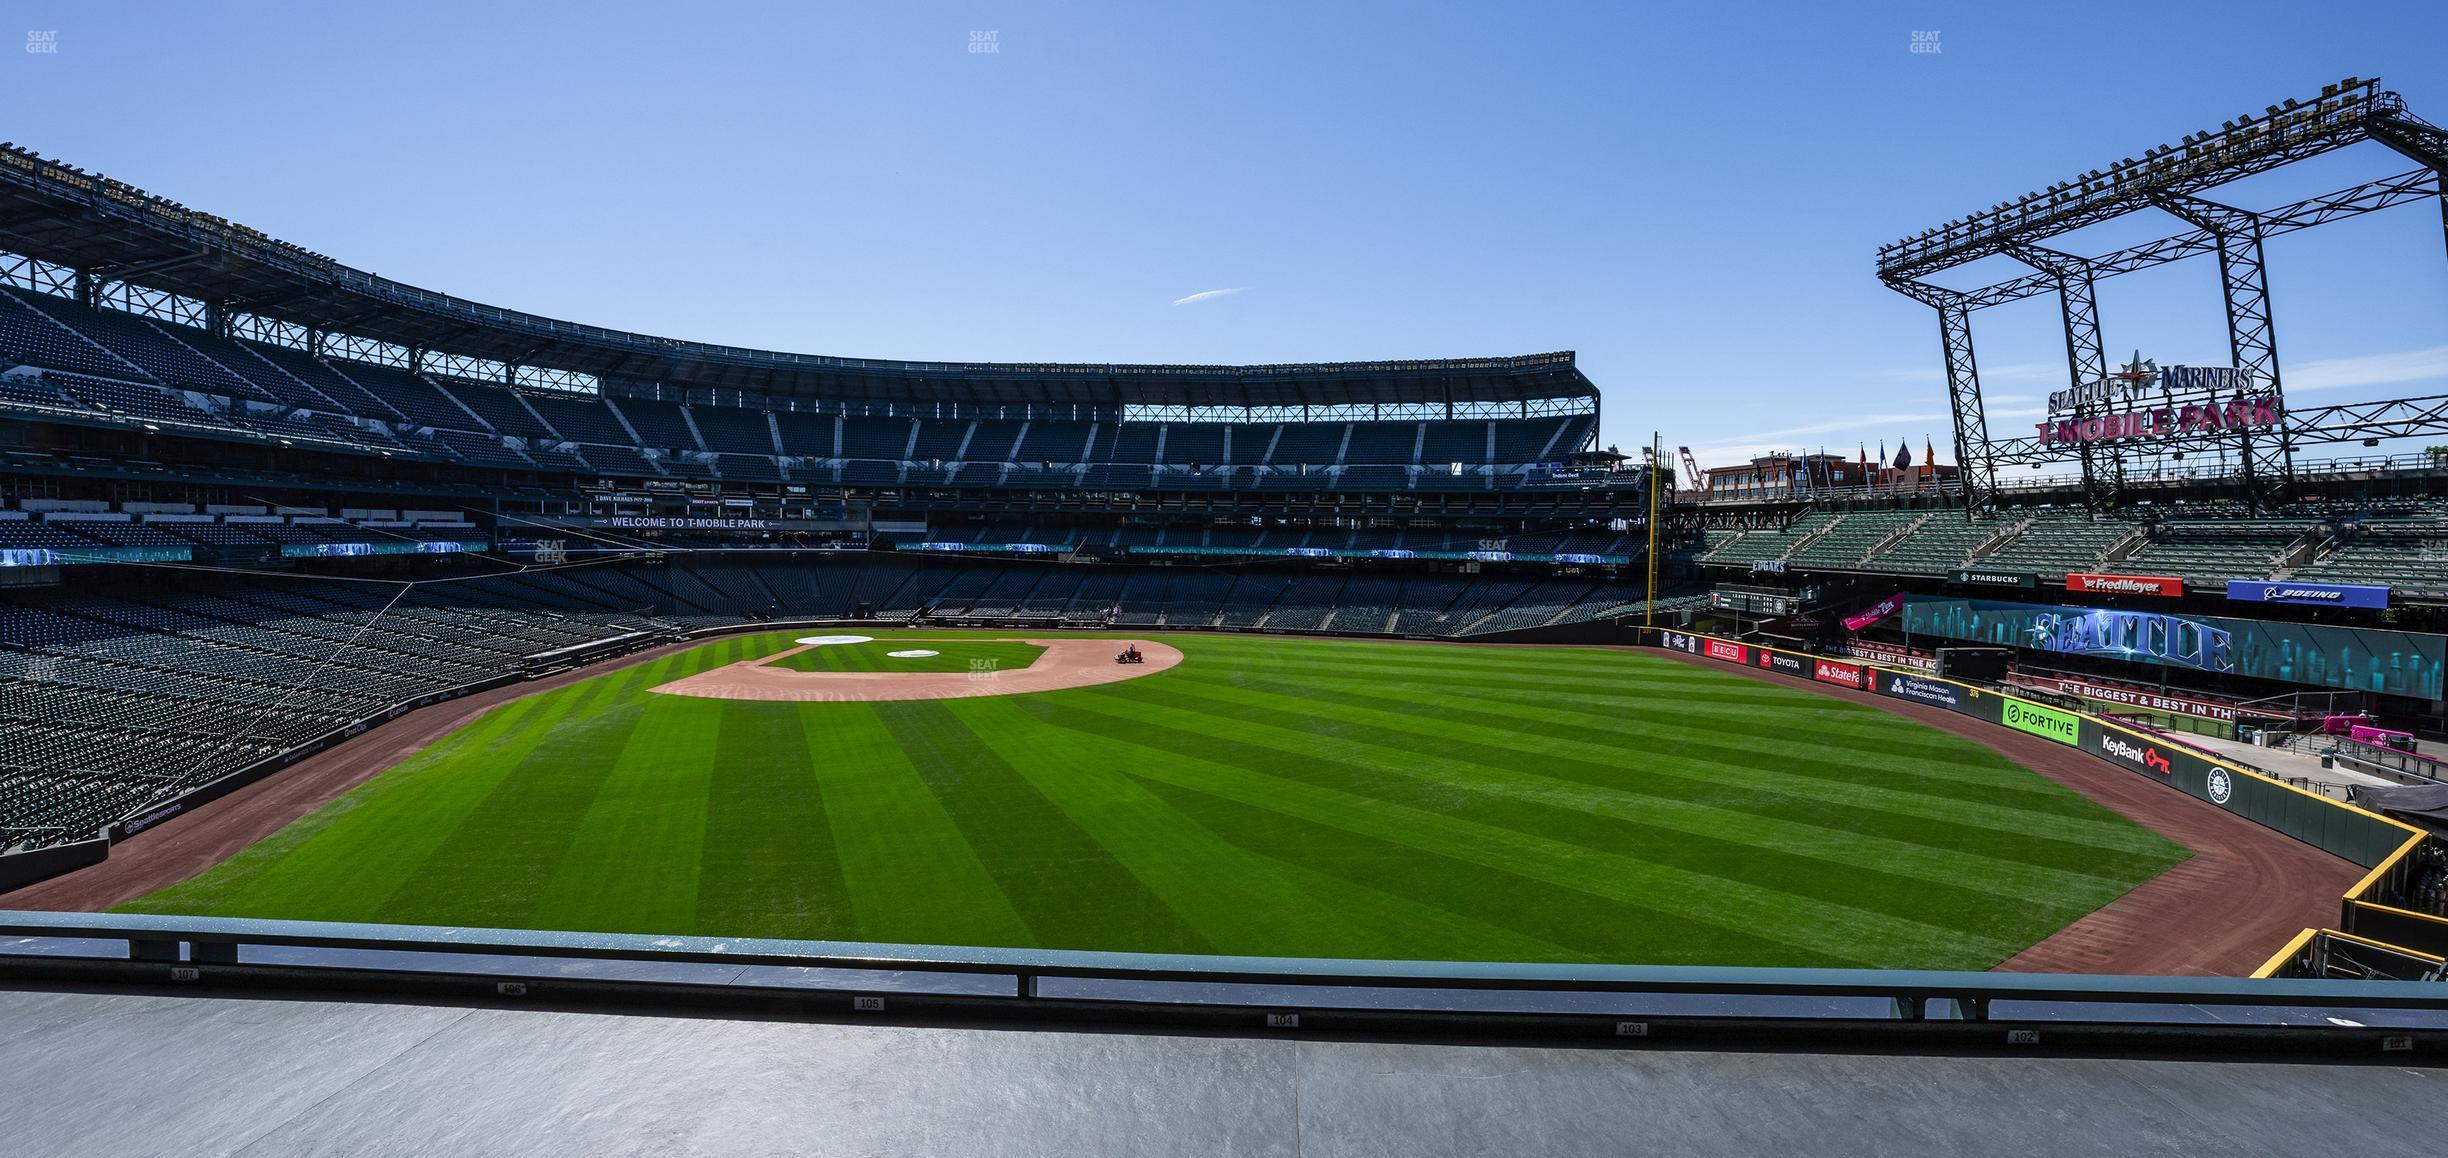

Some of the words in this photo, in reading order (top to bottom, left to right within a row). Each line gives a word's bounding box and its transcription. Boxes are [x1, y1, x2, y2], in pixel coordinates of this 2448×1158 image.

[2048, 378, 2120, 415] SEATTLE
[2160, 364, 2254, 391] MARINERS
[2035, 406, 2174, 446] T-MOBILE
[2180, 394, 2284, 433] PARK
[612, 517, 666, 528] WELCOME
[670, 518, 684, 528] TO
[688, 518, 736, 528] T-MOBILE
[738, 519, 765, 529] PARK
[1971, 574, 2018, 584] STARBUCKS
[2282, 589, 2341, 599] BOEING
[1713, 644, 1738, 657] BECU
[1825, 645, 1838, 653] THE
[1869, 650, 1875, 659] &
[1877, 651, 1897, 663] BEST
[1898, 656, 1906, 664] IN
[1908, 658, 1924, 668] THE
[1773, 656, 1800, 669] TOYOTA
[1905, 679, 1928, 691] Virginia
[1929, 684, 1949, 695] Mason
[1905, 687, 1937, 700] Franciscan
[1937, 693, 1956, 705] Health
[2058, 682, 2080, 694] THE
[2083, 686, 2137, 704] BIGGEST
[2140, 695, 2149, 705] &
[2153, 697, 2188, 712] BEST
[2192, 704, 2207, 715] IN
[2022, 710, 2074, 736] FORTIVE
[2102, 734, 2144, 764] KeyBank
[178, 970, 193, 979] 107
[861, 999, 879, 1008] 105
[1274, 1015, 1293, 1025] 104
[1623, 1024, 1641, 1033] 103
[2015, 1032, 2033, 1041] 102
